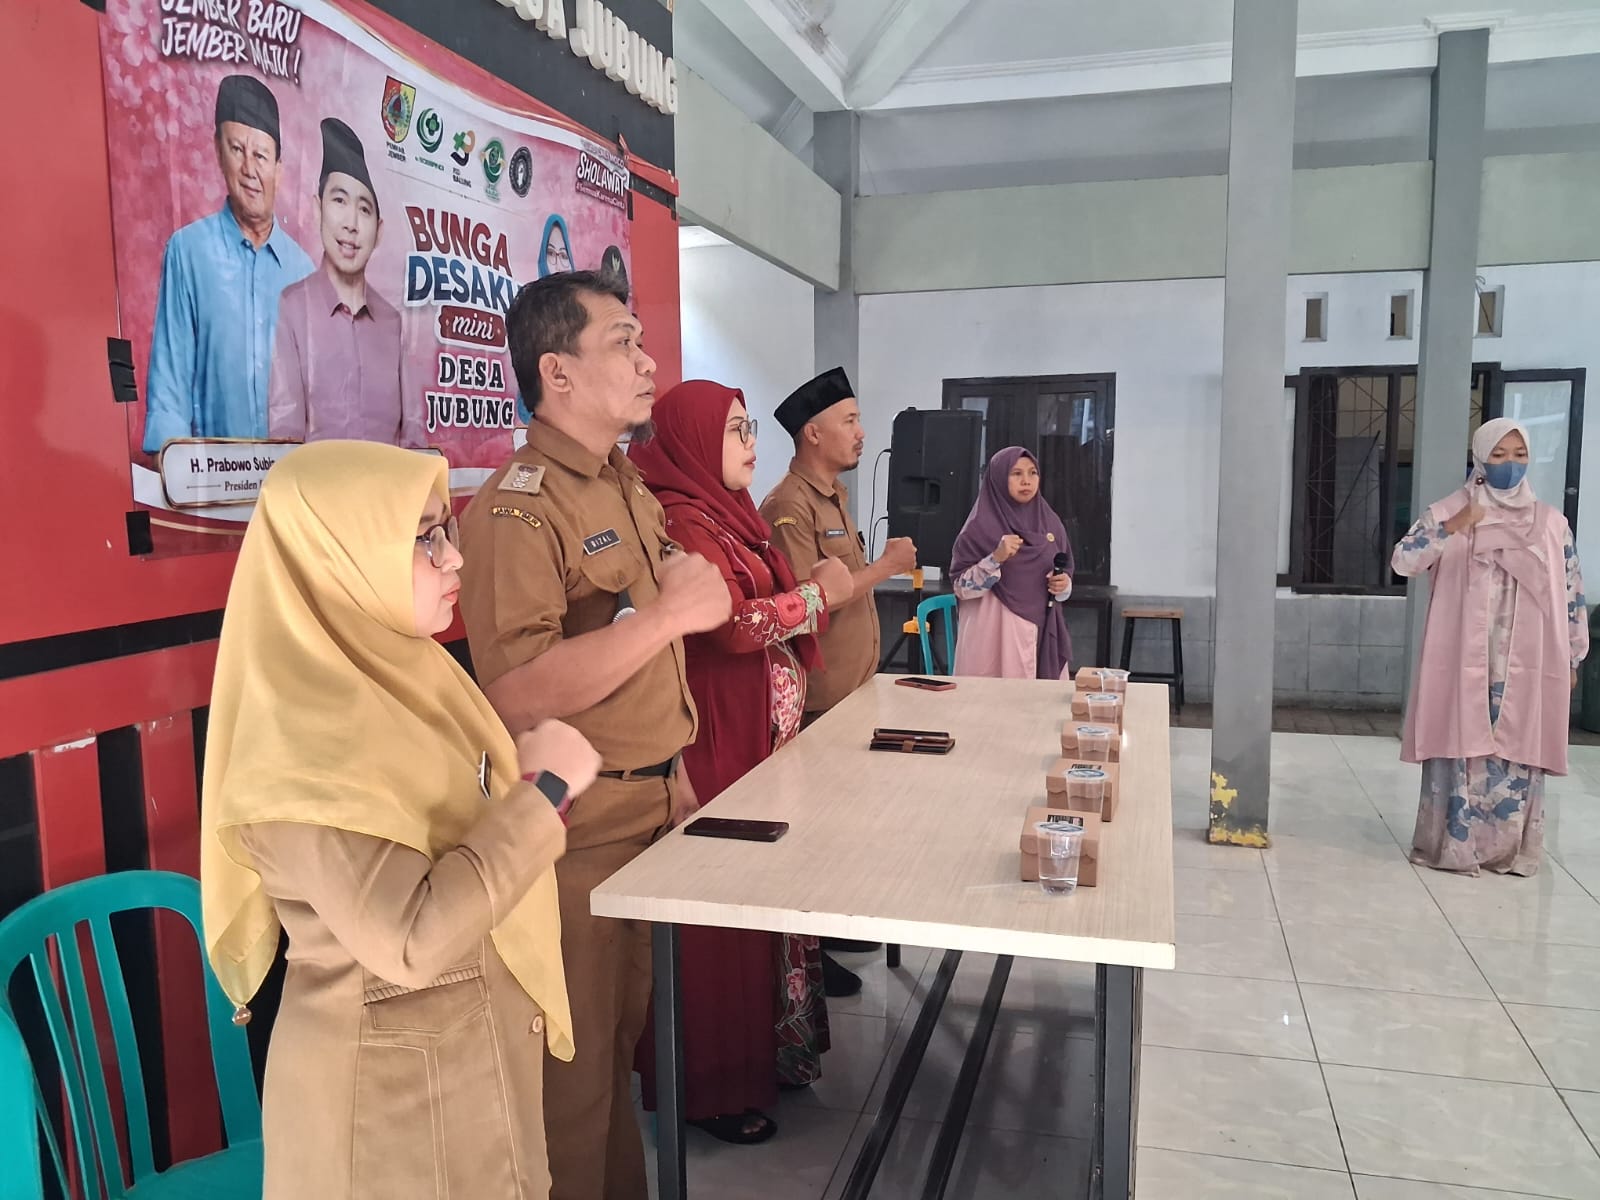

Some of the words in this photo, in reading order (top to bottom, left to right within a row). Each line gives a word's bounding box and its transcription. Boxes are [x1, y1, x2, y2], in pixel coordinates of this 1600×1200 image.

[247, 0, 301, 44] BARU
[162, 17, 249, 63] JEMBER
[249, 38, 289, 78] MAJU
[569, 0, 678, 115] JUBUNG
[577, 152, 626, 197] SHOLAWAT
[405, 206, 513, 278] BUNGA
[452, 312, 494, 340] mini
[440, 356, 504, 389] DESA
[427, 395, 513, 429] JUBUNG
[190, 459, 204, 473] H.
[207, 457, 252, 472] Prabowo
[224, 480, 258, 491] Presiden
